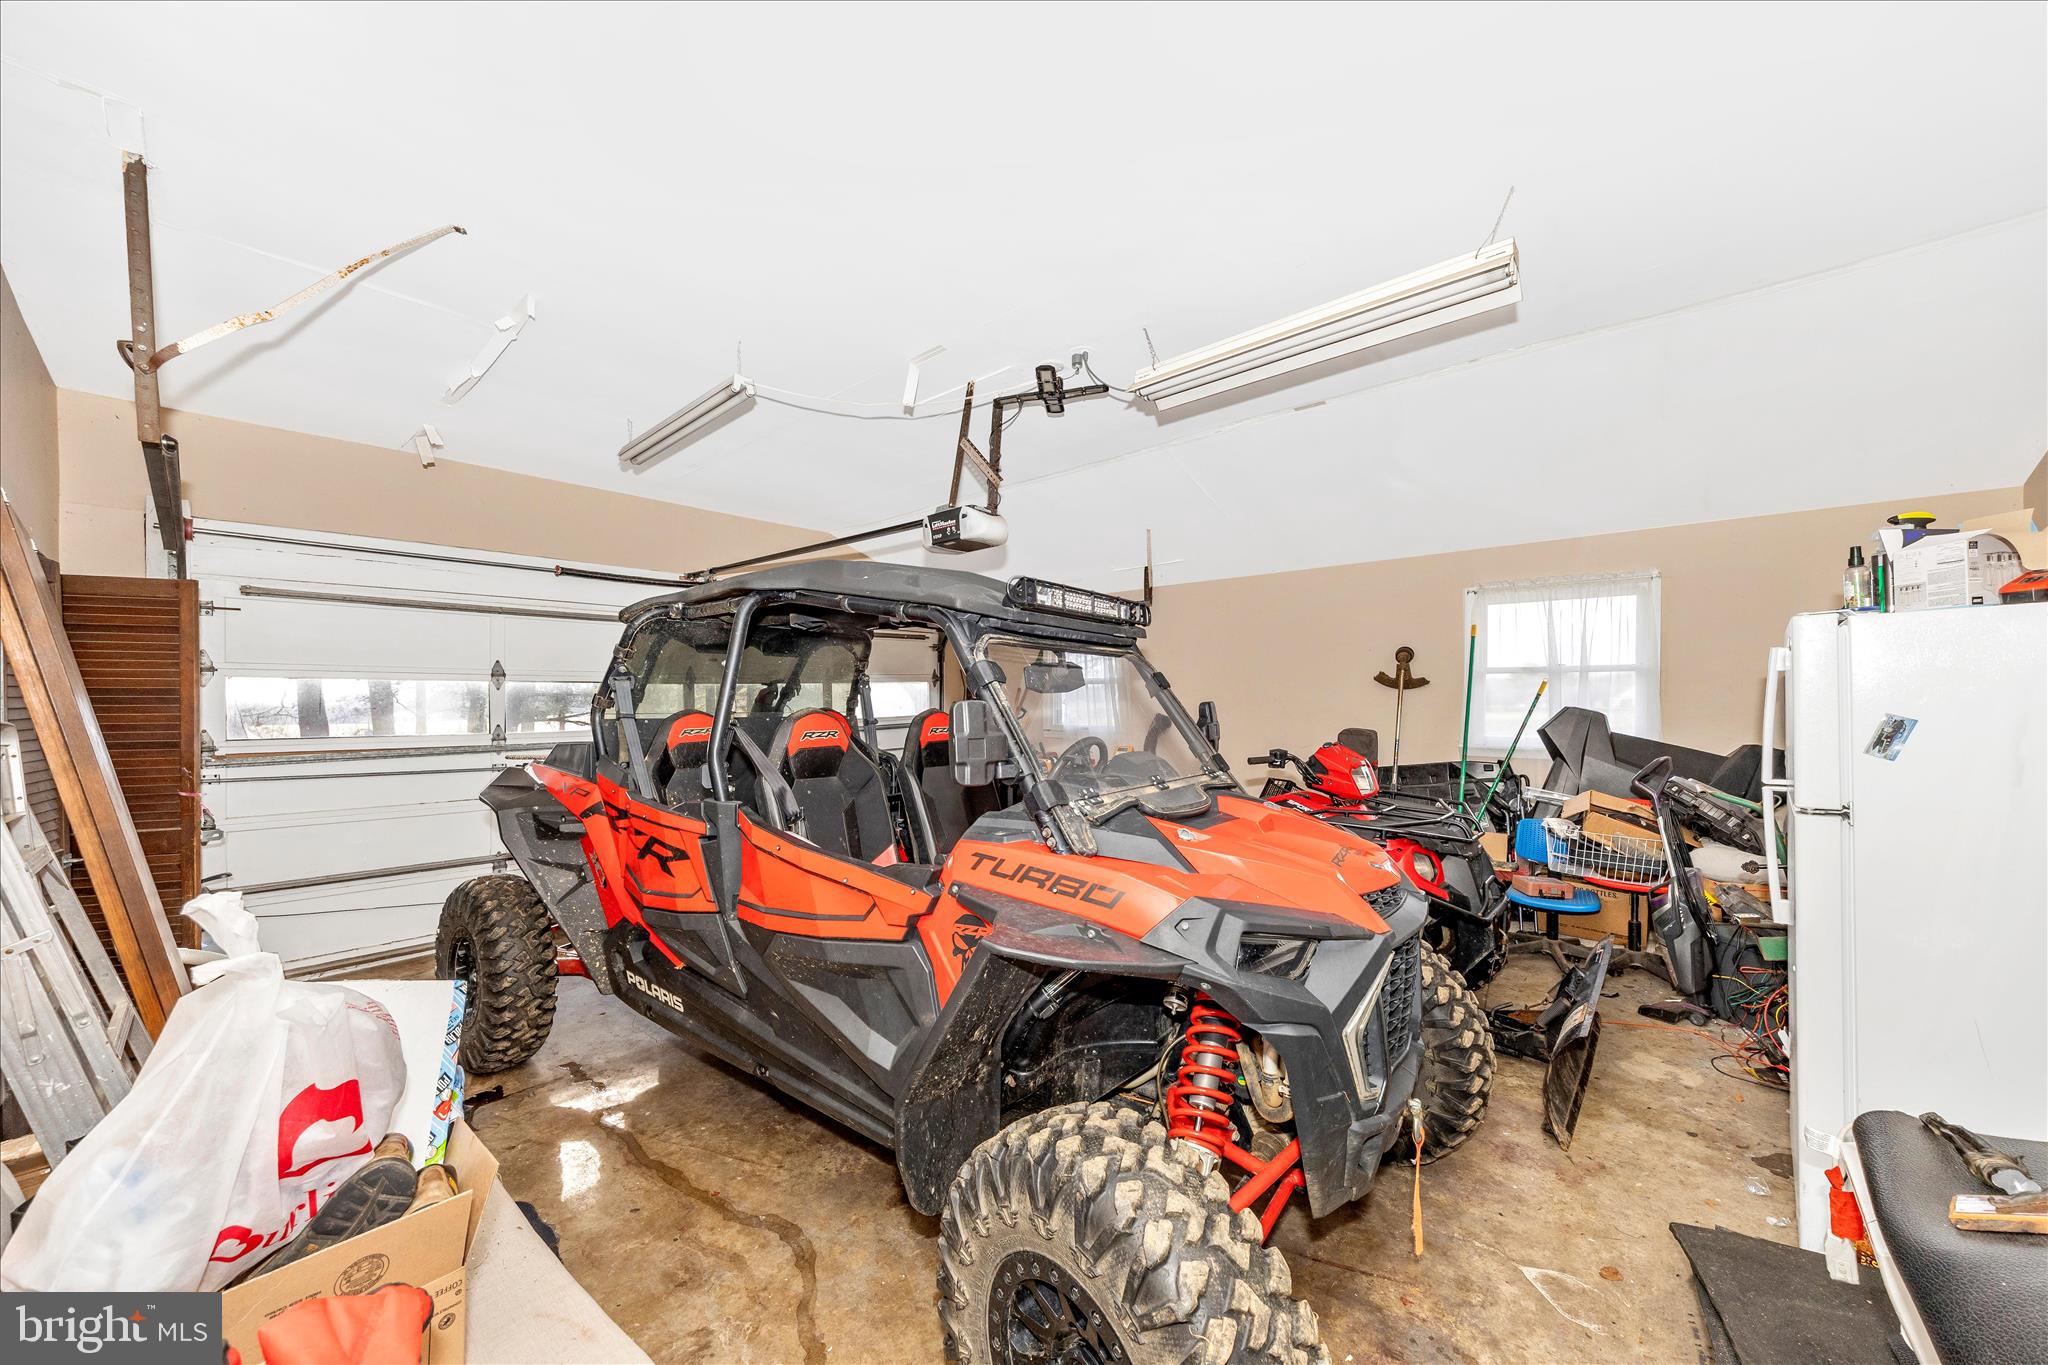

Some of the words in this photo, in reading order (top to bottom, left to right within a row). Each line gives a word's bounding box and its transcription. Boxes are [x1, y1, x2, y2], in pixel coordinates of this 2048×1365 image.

[800, 729, 839, 741] RZR
[970, 851, 1126, 910] TURBO
[625, 969, 685, 1013] POLARIS
